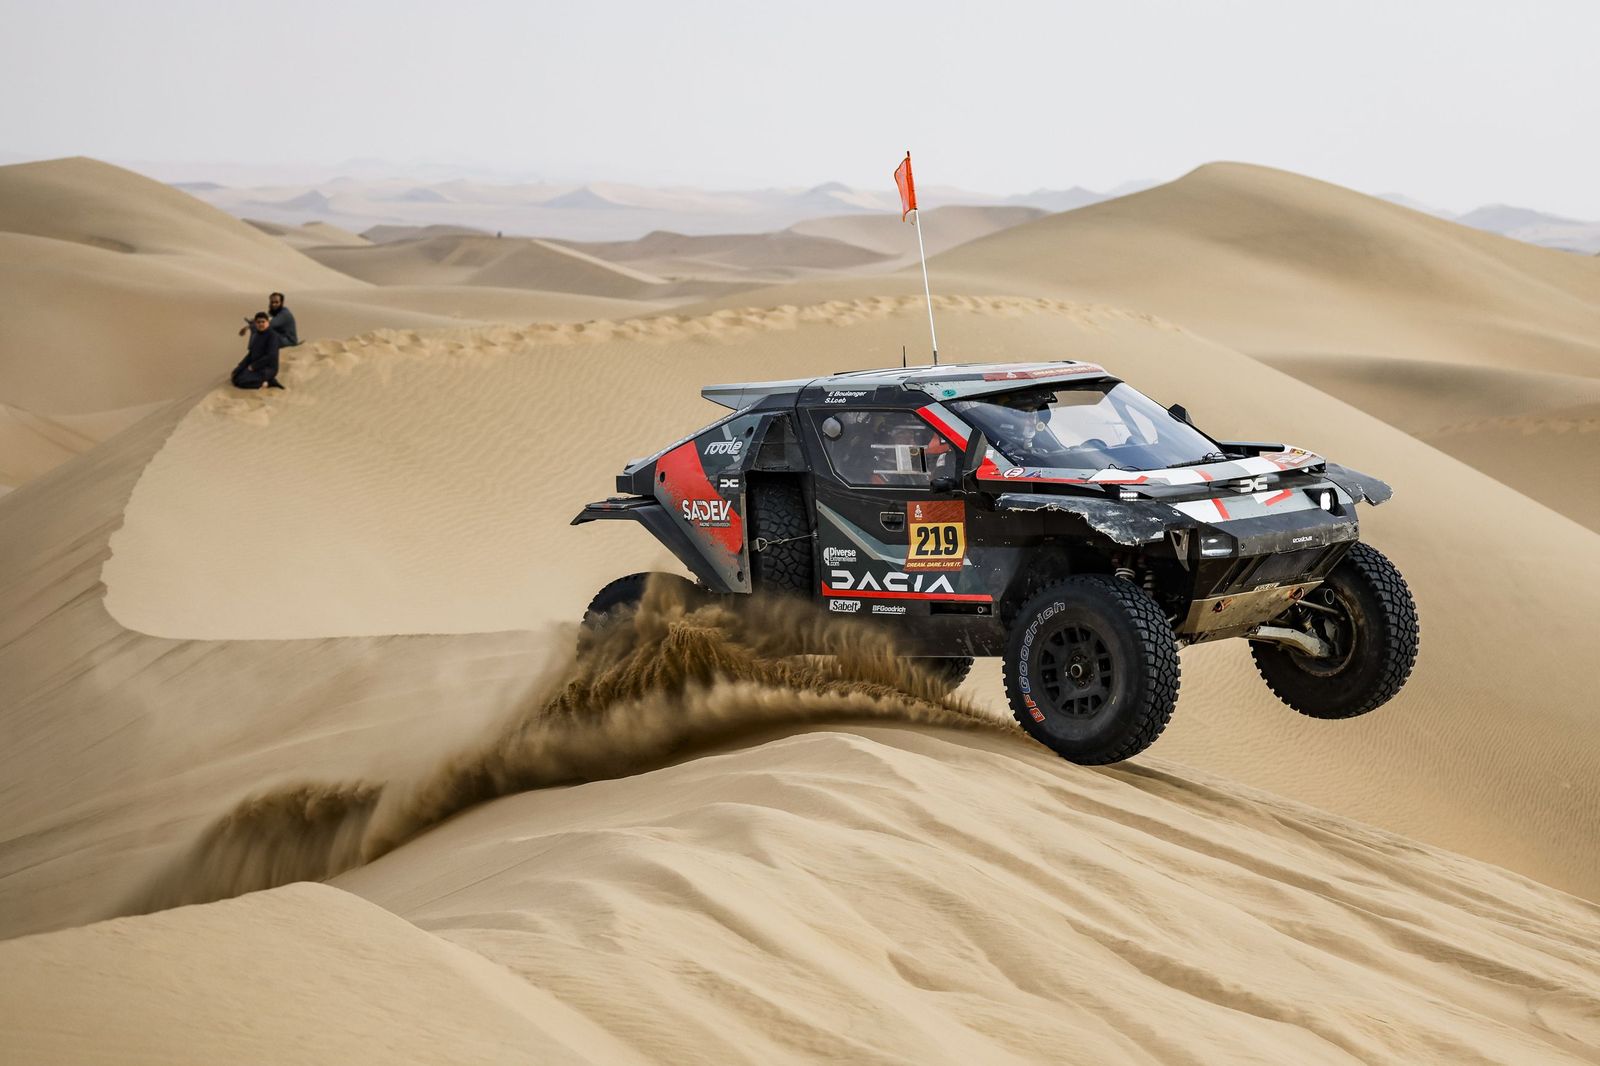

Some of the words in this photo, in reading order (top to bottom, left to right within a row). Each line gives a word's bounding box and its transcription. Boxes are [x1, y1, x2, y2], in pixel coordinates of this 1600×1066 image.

[682, 500, 731, 521] SADEV
[915, 526, 959, 556] 219
[829, 547, 857, 557] Diverse
[831, 569, 955, 593] DACIA
[832, 600, 858, 611] Sabelt
[872, 604, 906, 613] BFGoodrich
[1018, 601, 1066, 723] BFGoodrich
